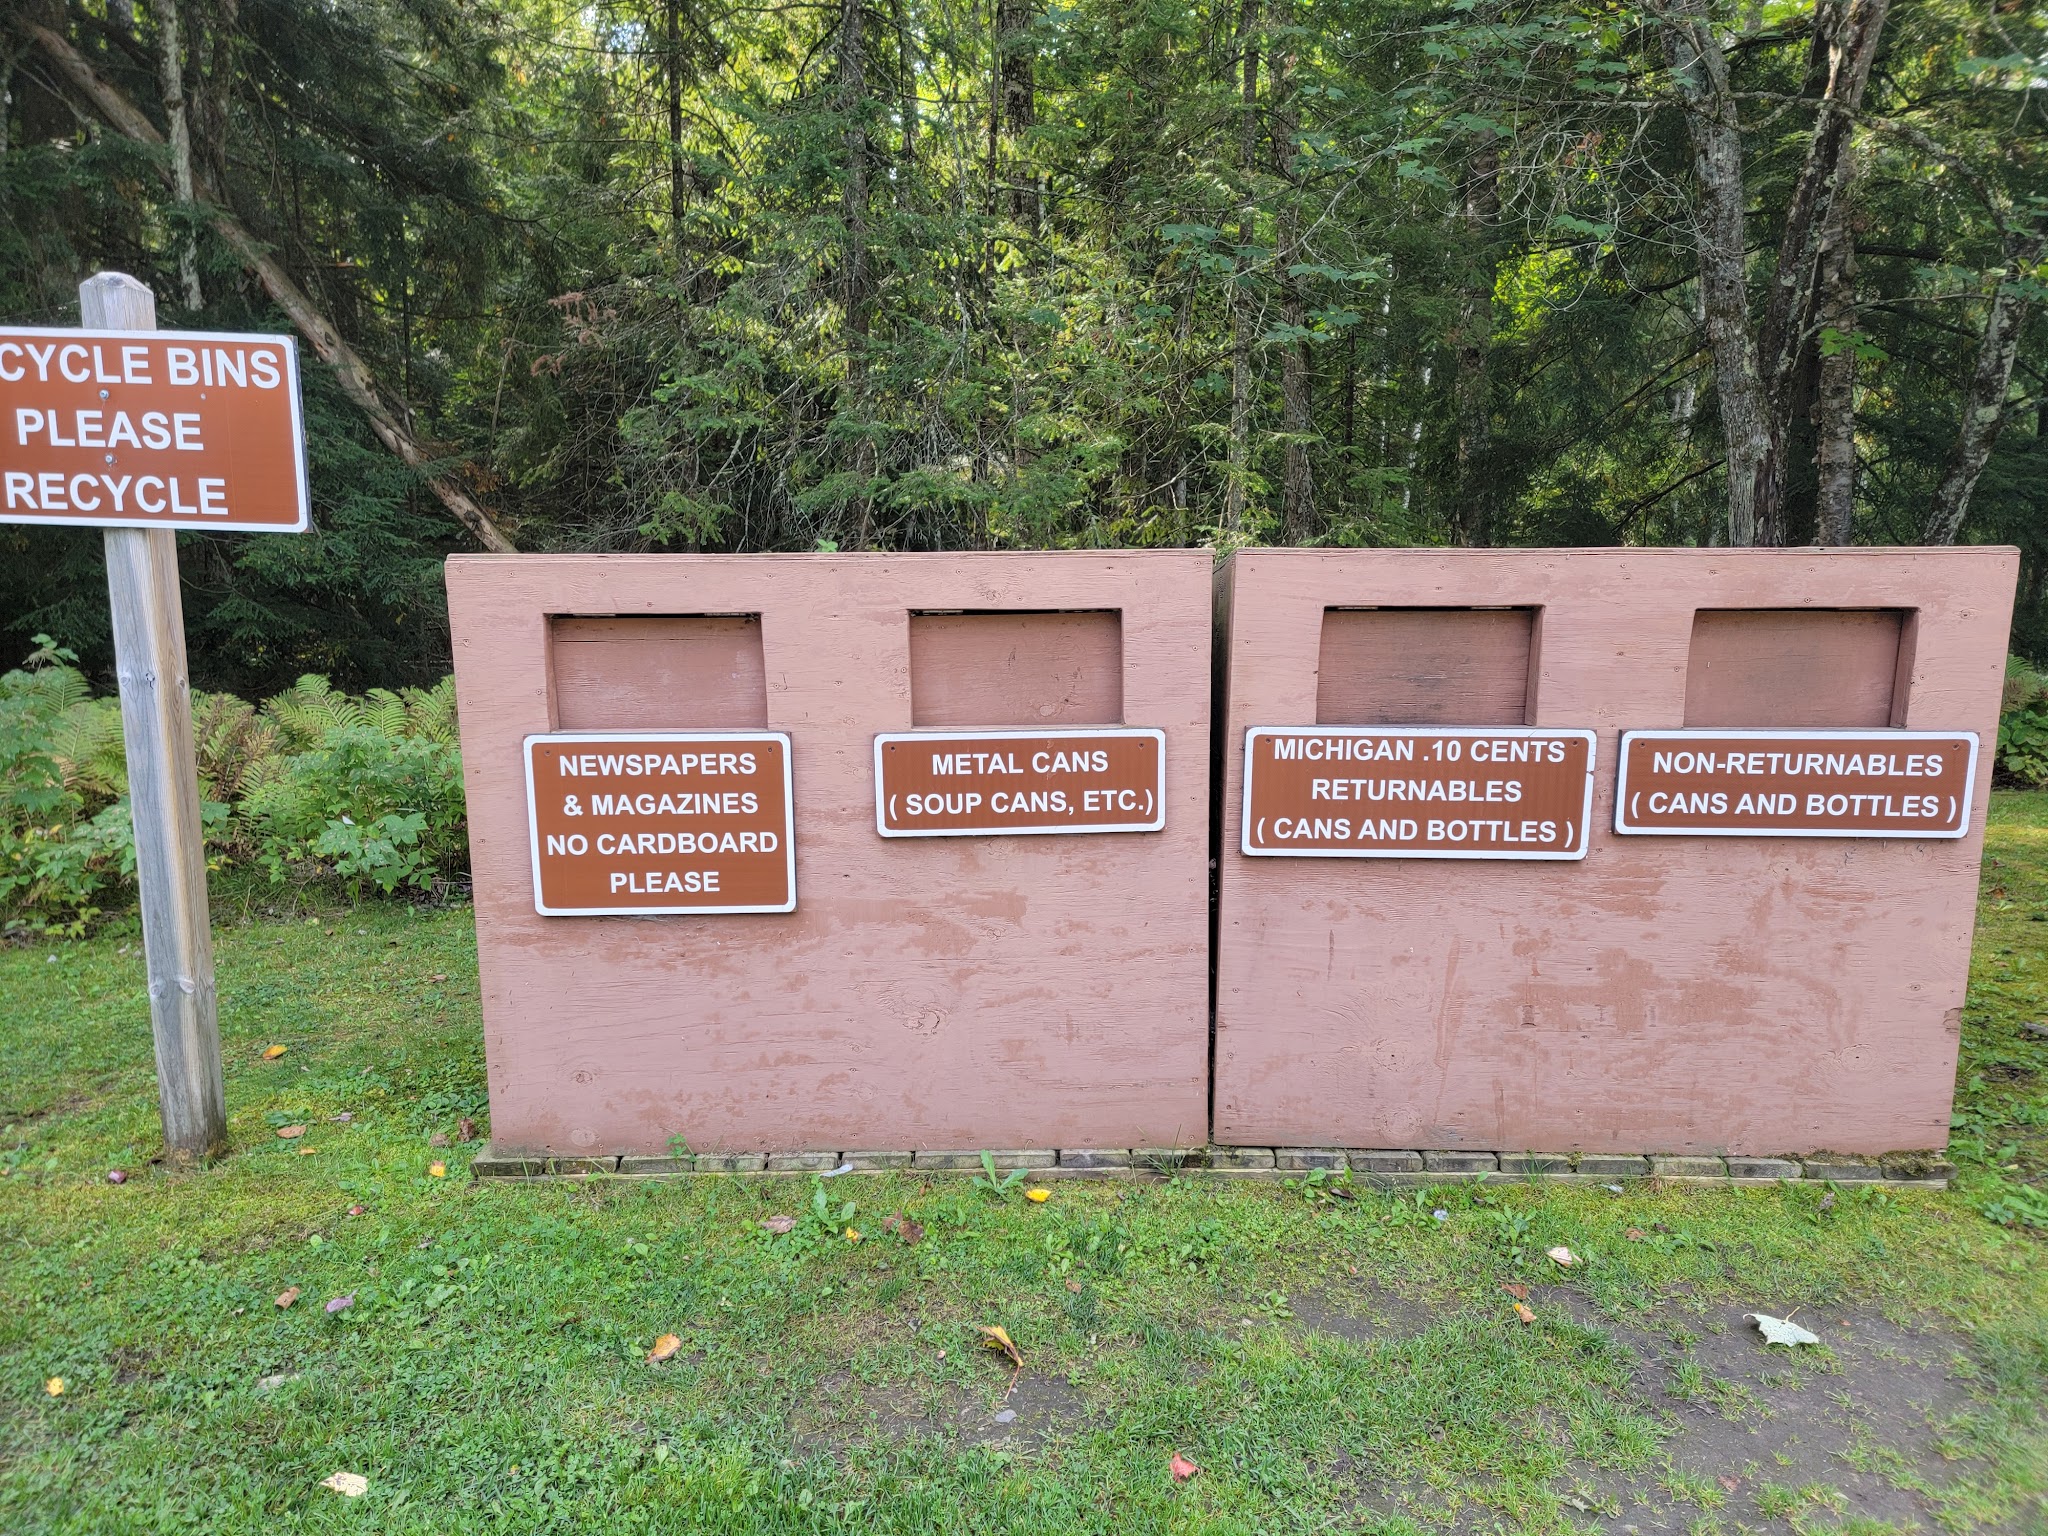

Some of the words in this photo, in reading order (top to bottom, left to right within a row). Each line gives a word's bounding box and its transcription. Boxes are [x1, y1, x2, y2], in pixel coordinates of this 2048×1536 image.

[167, 347, 281, 389] BINS
[16, 408, 204, 450] PLEASE
[4, 472, 229, 516] RECYCLE
[1274, 738, 1414, 761] MICHIGAN
[1423, 740, 1461, 762] .10
[1470, 740, 1565, 763] CENTS
[560, 753, 756, 776] NEWSPAPERS
[933, 753, 1023, 775] METAL
[1032, 751, 1108, 773] CANS
[1654, 752, 1942, 776] NON-RETURNABLES
[906, 793, 982, 815] SOUP
[991, 791, 1073, 815] CANS,
[1084, 789, 1153, 815] ETC.)
[1312, 779, 1521, 802] RETURNABLES
[564, 795, 583, 816] &
[592, 793, 758, 815] MAGAZINES
[1649, 792, 1728, 814] CANS
[1735, 794, 1796, 814] AND
[1806, 794, 1939, 817] BOTTLES
[1274, 818, 1350, 839] CANS
[1358, 819, 1417, 840] AND
[1427, 820, 1556, 842] BOTTLES
[547, 834, 588, 855] NO
[597, 832, 777, 854] CARDBOARD
[611, 872, 720, 893] PLEASE
